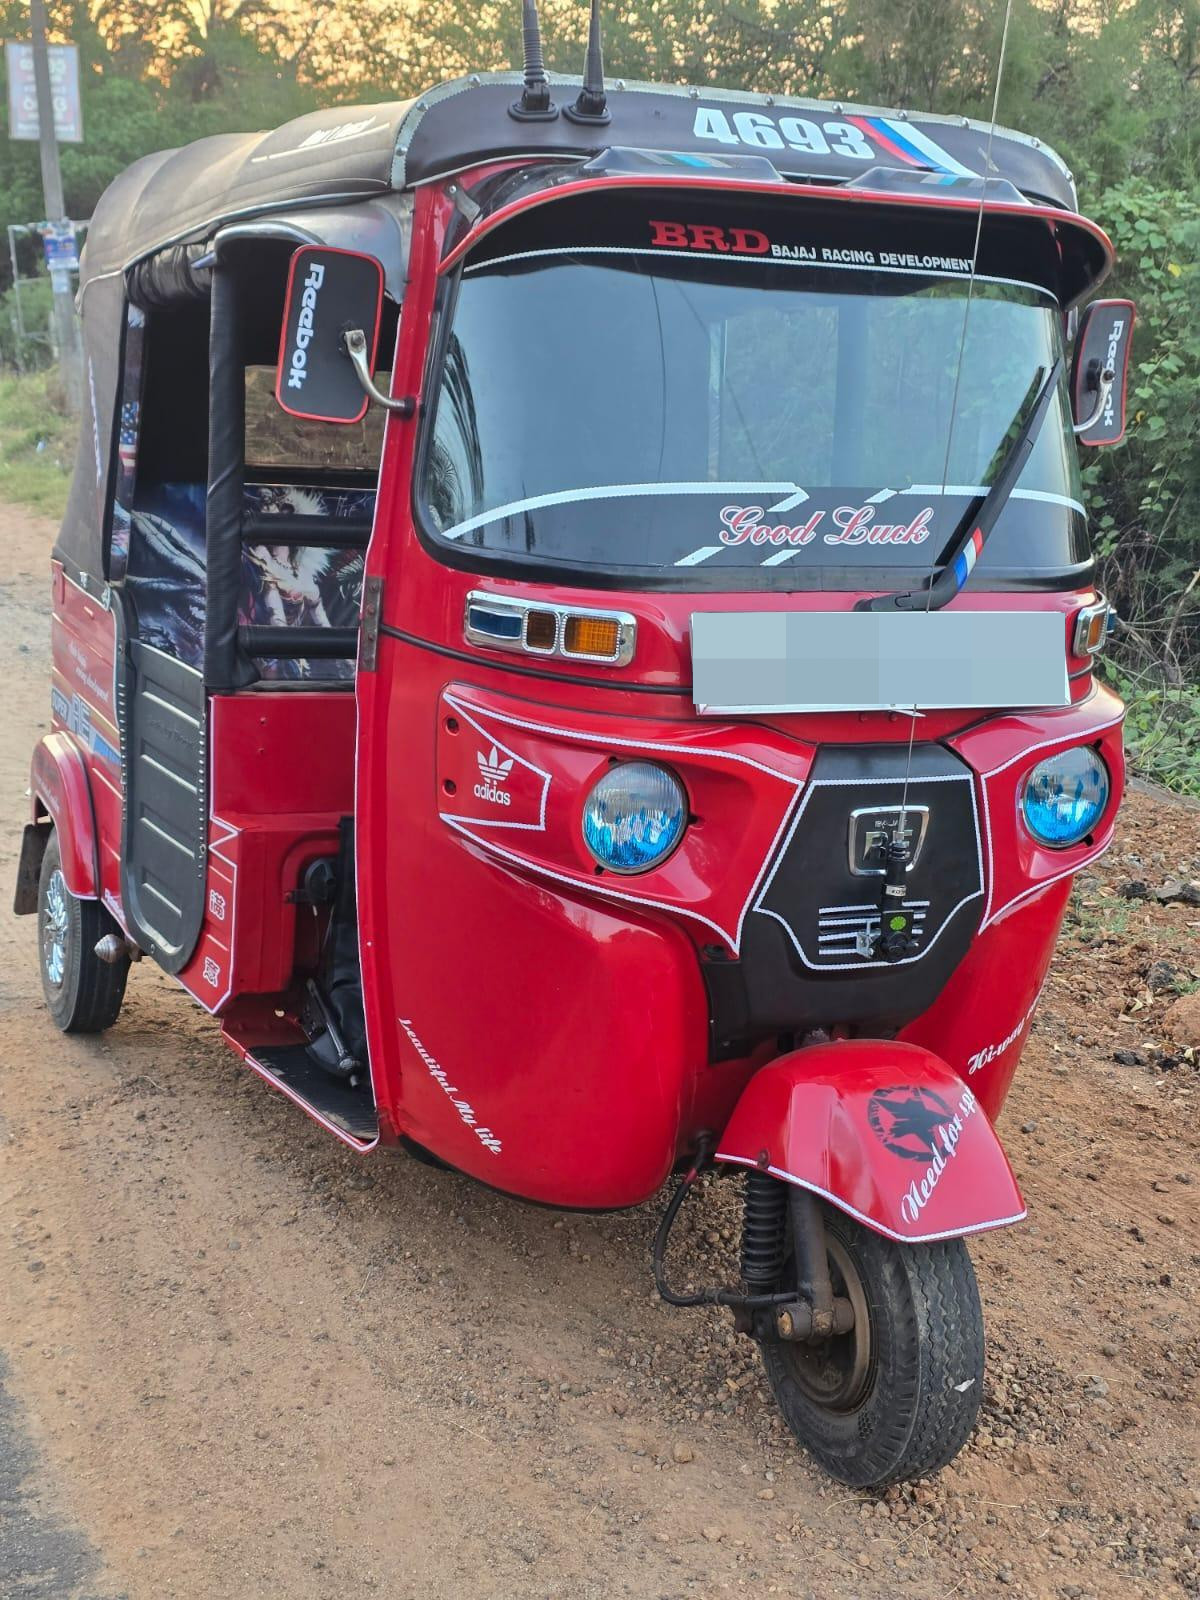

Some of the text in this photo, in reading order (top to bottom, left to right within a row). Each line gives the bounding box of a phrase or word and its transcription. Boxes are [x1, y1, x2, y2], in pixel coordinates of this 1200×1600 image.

[693, 107, 875, 159] 4693
[649, 220, 770, 254] BRD
[771, 244, 974, 272] BAJAJ RACING DEVELOPMENT
[288, 262, 326, 390] Reebok
[1104, 320, 1125, 427] Reeok
[718, 505, 935, 546] Good Luck
[473, 781, 512, 807] adidas
[901, 1142, 947, 1225] Need
[938, 1112, 964, 1157] for
